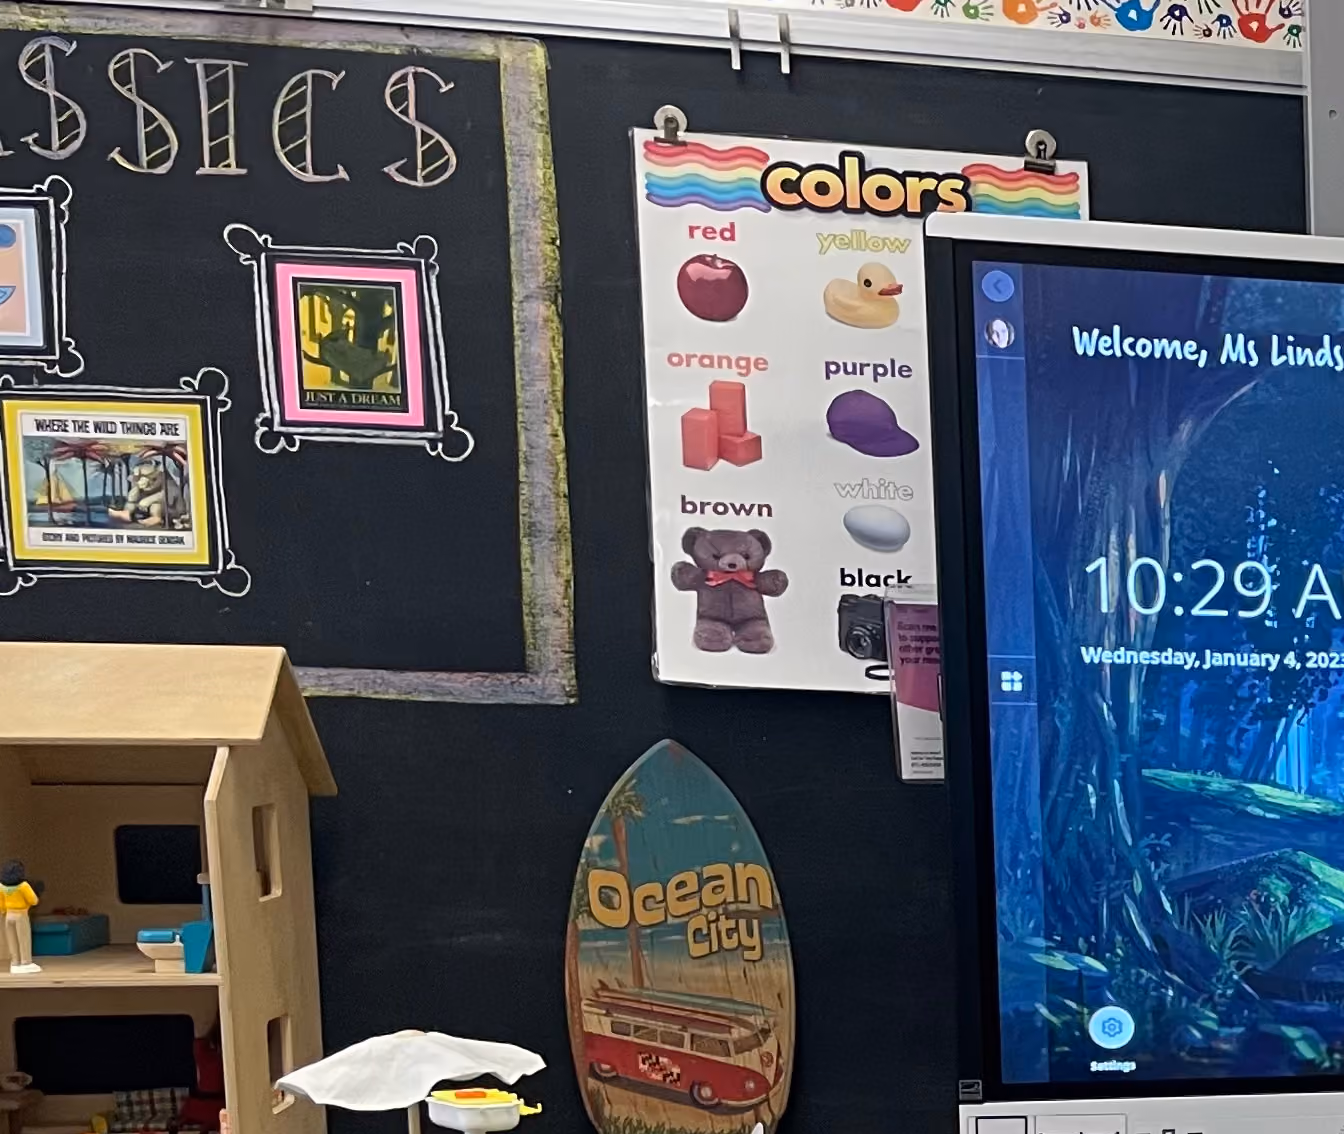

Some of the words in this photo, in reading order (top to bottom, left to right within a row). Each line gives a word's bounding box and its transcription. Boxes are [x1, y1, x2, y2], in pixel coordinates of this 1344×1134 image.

[0, 36, 457, 188] SSICS
[762, 152, 970, 215] colors
[688, 221, 737, 242] red
[816, 229, 912, 255] yellow
[1072, 325, 1208, 368] Welcome,
[1220, 333, 1258, 367] Ms
[667, 351, 769, 377] orange
[824, 358, 913, 383] purple
[305, 391, 335, 402] JUST
[339, 393, 348, 404] A
[351, 393, 401, 406] DREAM
[34, 418, 69, 433] WHERE
[71, 419, 90, 434] THE
[93, 420, 117, 435] WILD
[120, 421, 157, 436] THINGS
[159, 422, 180, 437] ARE
[833, 478, 914, 500] white
[680, 495, 773, 518] brown
[840, 568, 913, 588] black
[1086, 555, 1273, 617] 10:29
[1081, 646, 1201, 670] Wednesday,
[1204, 648, 1279, 670] January
[1283, 649, 1301, 670] 4,
[587, 862, 773, 929] Ocean
[686, 910, 763, 962] City
[1090, 1060, 1137, 1073] Settings
